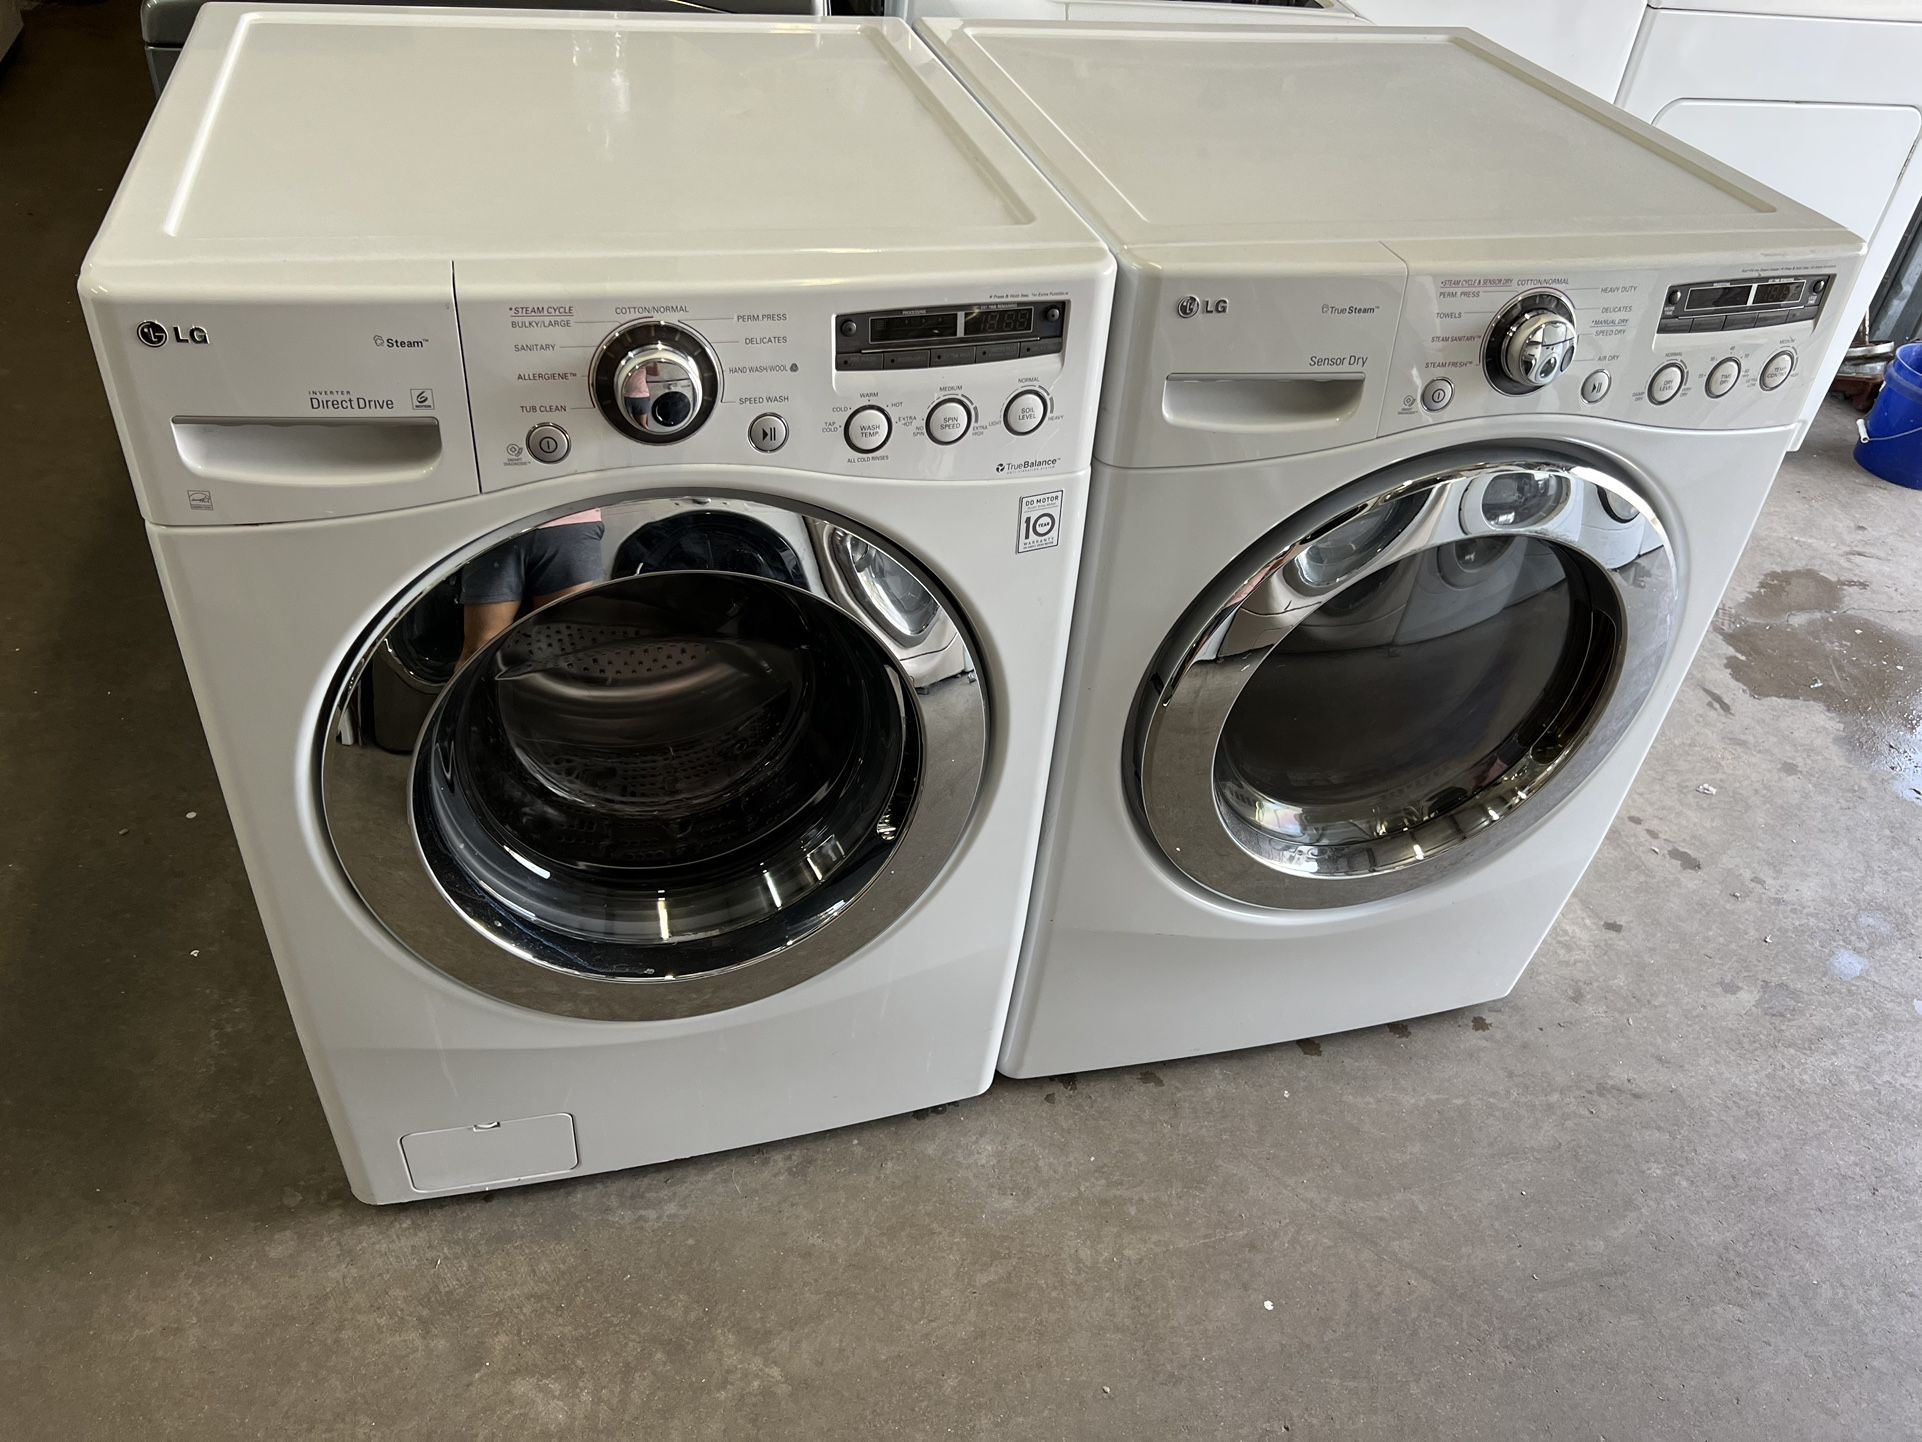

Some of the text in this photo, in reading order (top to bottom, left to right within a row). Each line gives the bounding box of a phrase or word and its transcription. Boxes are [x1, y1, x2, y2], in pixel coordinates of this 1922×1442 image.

[1516, 278, 1569, 286] COTTON/NORMAL
[546, 306, 574, 314] CYCLE
[615, 305, 689, 315] COTTON/NORMAL
[1204, 299, 1229, 313] LG
[761, 313, 787, 321] PRESS
[511, 320, 572, 328] BULKY/LARGE
[172, 325, 210, 344] LG
[744, 336, 788, 345] DELICATES
[514, 344, 556, 352] SANITARY
[1309, 355, 1368, 368] Sensor Dry
[729, 366, 748, 374] HAND
[310, 397, 394, 409] Direct Drive
[765, 395, 789, 403] WASH
[520, 405, 537, 413] TUB
[940, 423, 960, 431] SPEED
[1036, 495, 1059, 504] MOTOR
[1024, 512, 1055, 540] 10
[1023, 537, 1055, 546] WARRANTY
